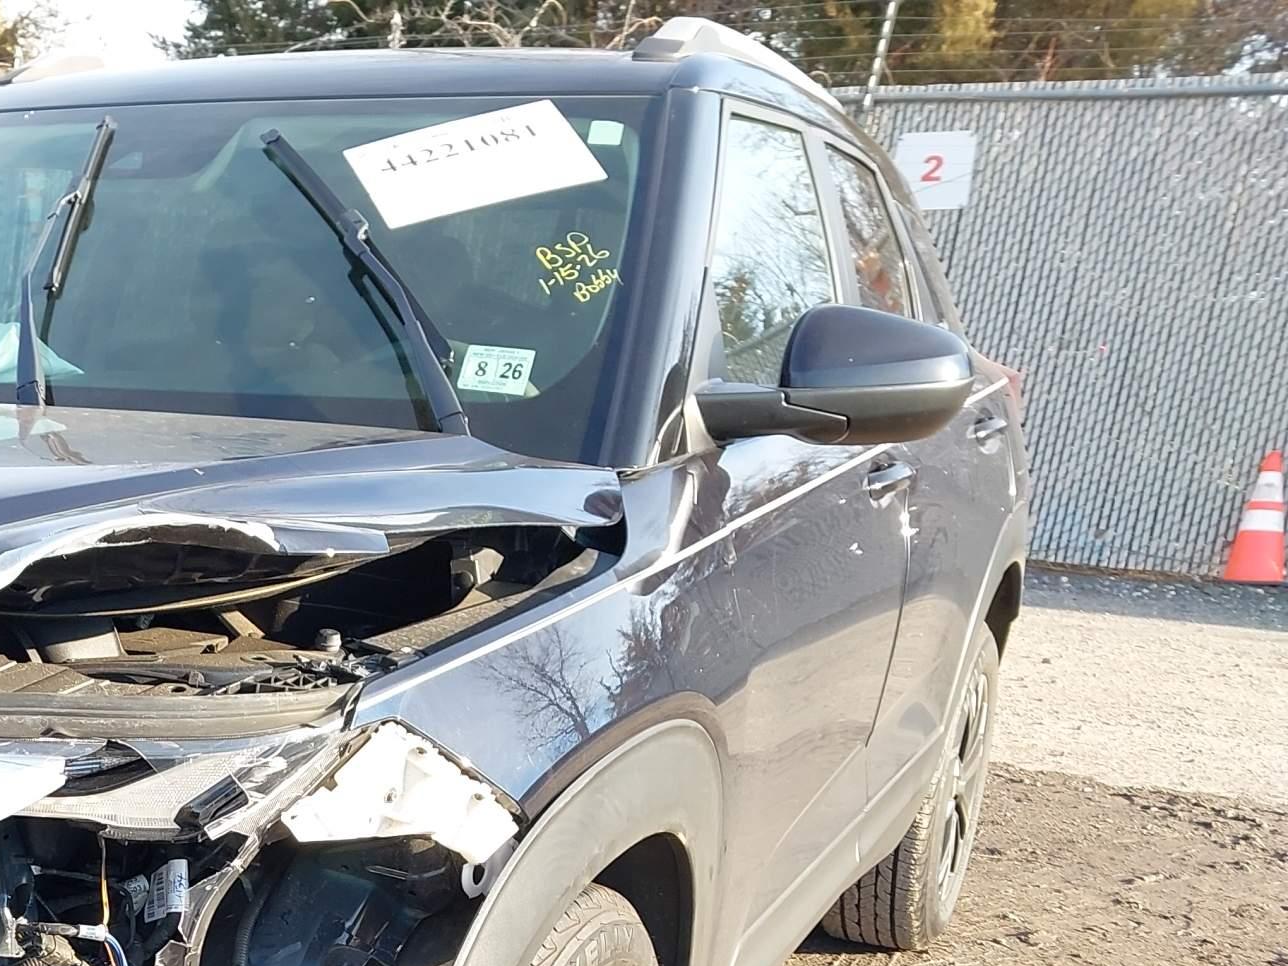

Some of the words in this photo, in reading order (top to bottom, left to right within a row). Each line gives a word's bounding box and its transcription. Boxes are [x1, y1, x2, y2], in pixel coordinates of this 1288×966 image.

[381, 125, 536, 171] 44221081
[921, 155, 943, 182] 2
[475, 360, 488, 377] 8
[499, 362, 523, 380] 26
